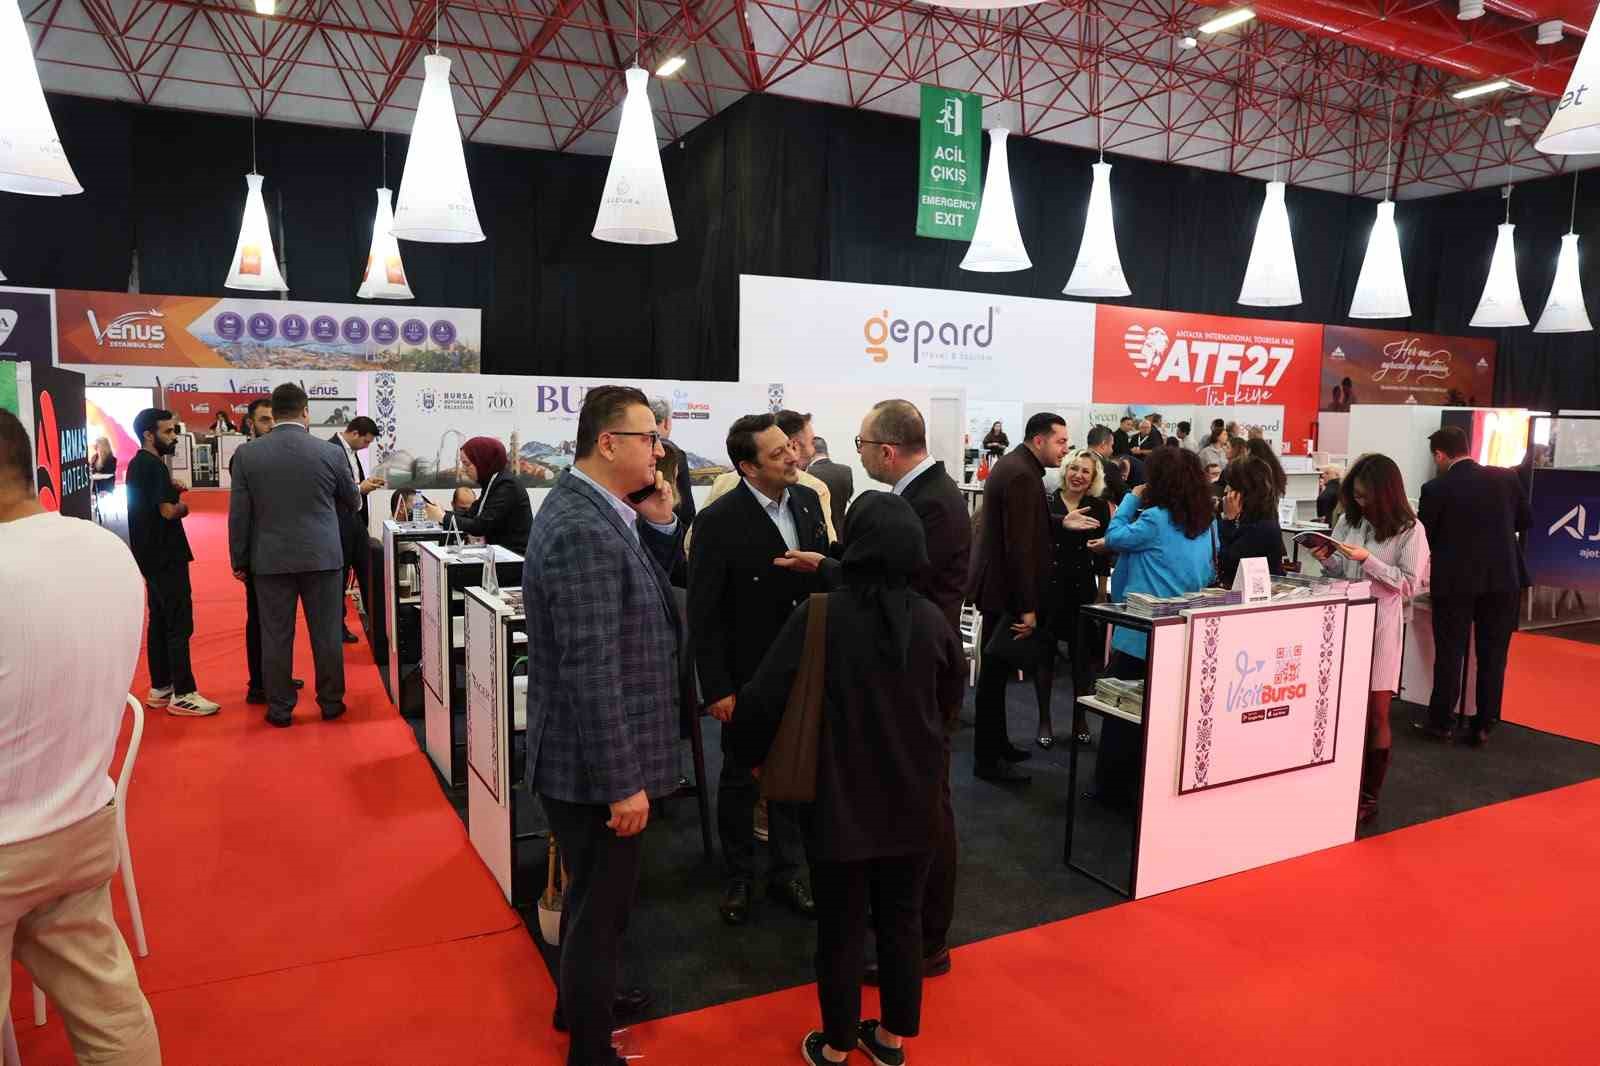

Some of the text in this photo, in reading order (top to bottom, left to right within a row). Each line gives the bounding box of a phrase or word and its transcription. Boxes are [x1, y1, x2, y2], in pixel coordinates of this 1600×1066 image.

[934, 145, 966, 163] ACİL
[930, 165, 968, 186] ÇIKIŞ
[921, 194, 977, 211] EMERGENCY
[935, 211, 965, 227] EXIT
[864, 306, 993, 364] gepard
[1175, 328, 1295, 346] ANTALYA INTERNATIONAL TOURISM FAIR
[1155, 339, 1295, 387] ATF27
[487, 396, 513, 409] 700
[61, 428, 87, 464] ARMAS
[62, 463, 89, 497] HOTELS
